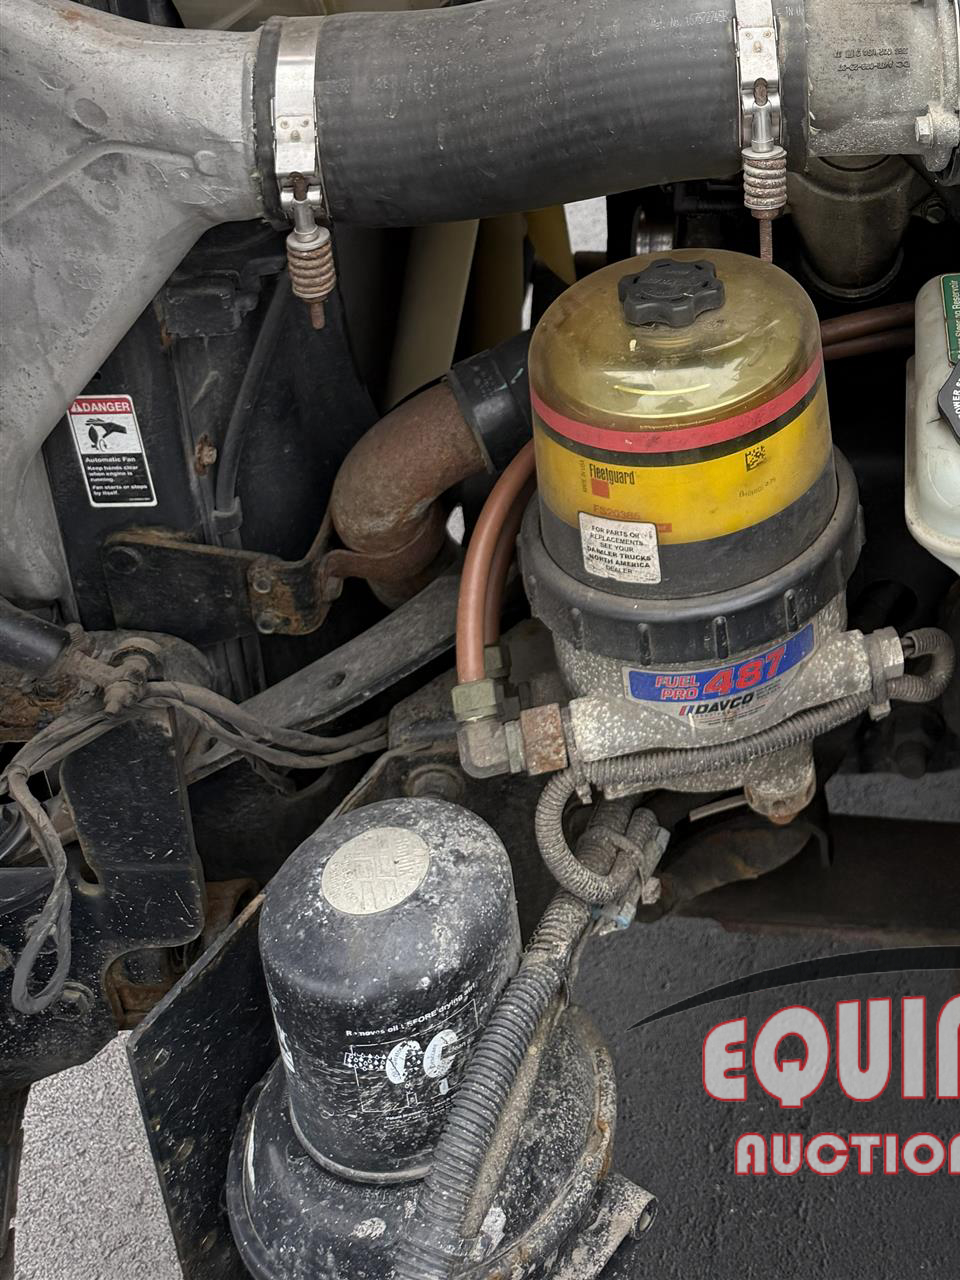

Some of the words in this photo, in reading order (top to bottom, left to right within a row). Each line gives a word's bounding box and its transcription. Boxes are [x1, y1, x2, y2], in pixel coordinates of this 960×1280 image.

[949, 279, 960, 310] Reservoir
[82, 402, 131, 412] DANGER
[589, 463, 636, 485] Fleetguard
[591, 525, 605, 533] FOR
[606, 528, 629, 538] PARTS
[590, 532, 644, 547] REPLACEMENTS
[586, 545, 618, 558] DAIMLER
[619, 552, 652, 562] TRUCKS
[600, 542, 615, 550] SEE
[616, 545, 634, 553] YOUR
[588, 555, 614, 565] NORTH
[615, 559, 651, 569] AMERICA
[605, 565, 633, 574] DEALER
[703, 644, 786, 696] 487
[655, 675, 701, 688] FUEL
[660, 687, 699, 700] PRO
[695, 692, 755, 715] DAVCO
[388, 1024, 399, 1033] oil
[437, 994, 463, 1012] drying
